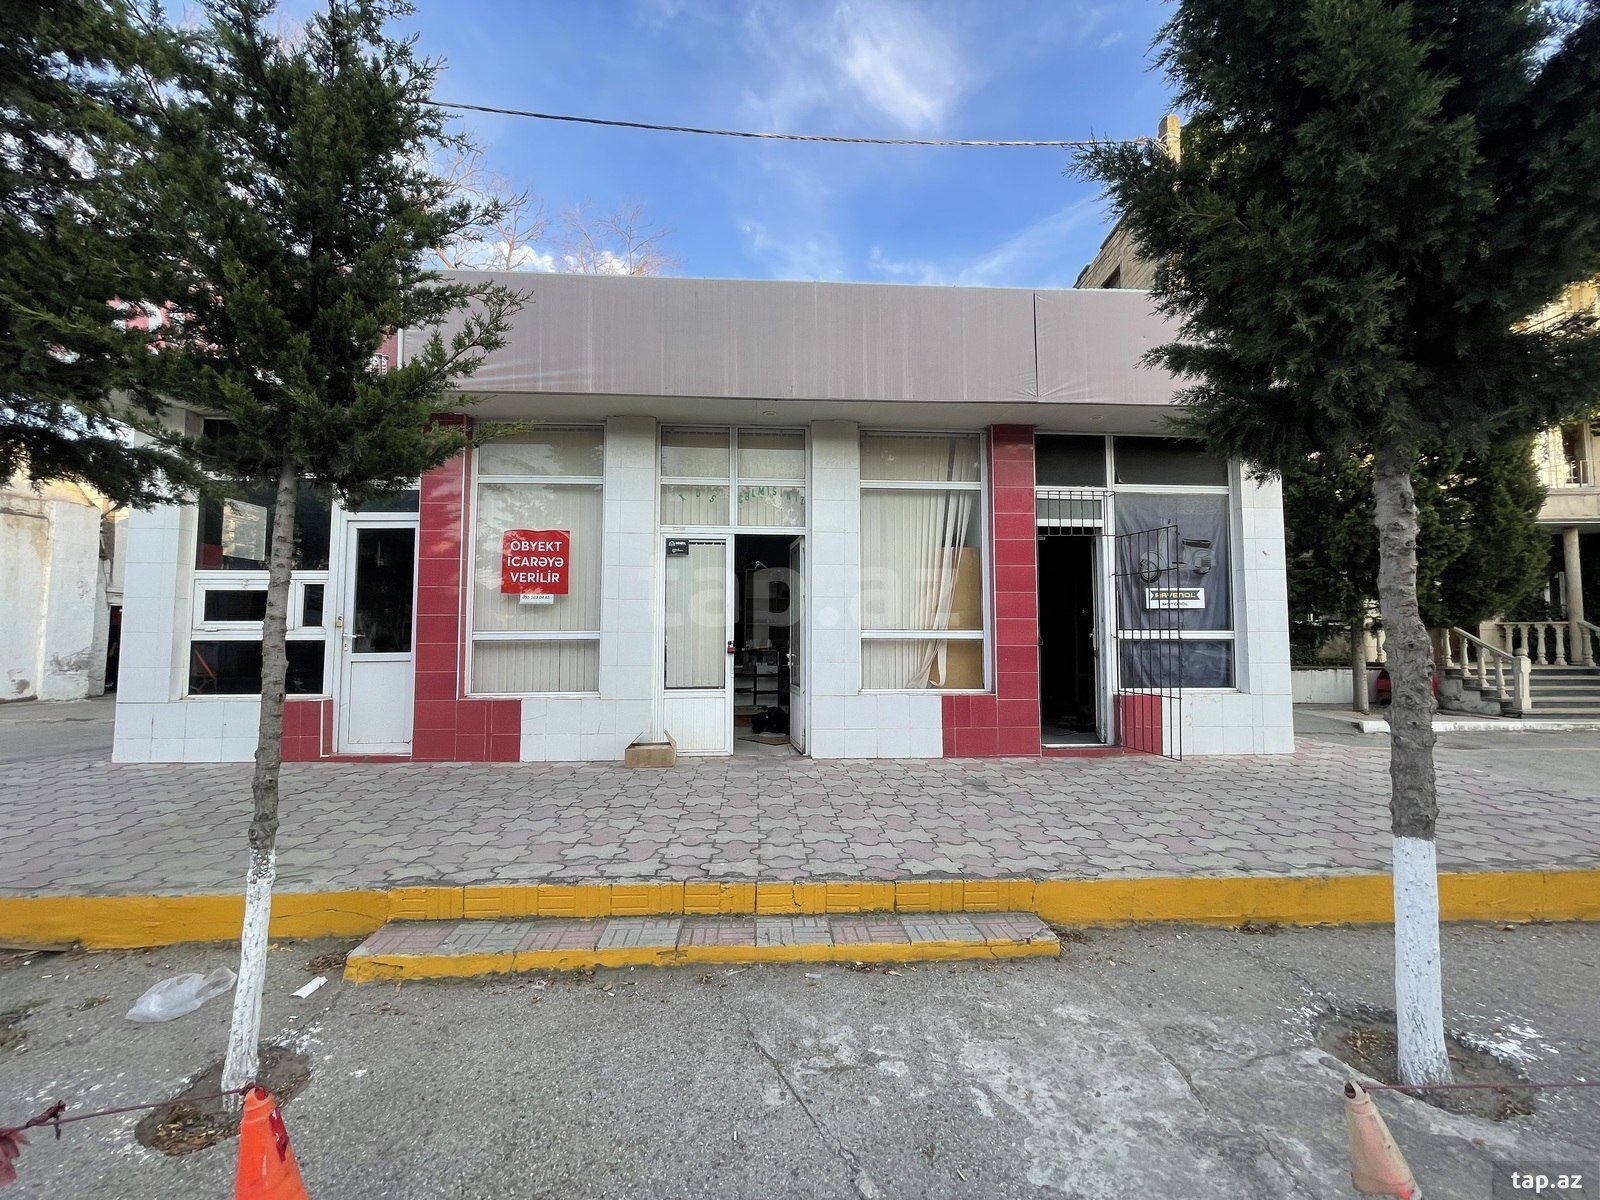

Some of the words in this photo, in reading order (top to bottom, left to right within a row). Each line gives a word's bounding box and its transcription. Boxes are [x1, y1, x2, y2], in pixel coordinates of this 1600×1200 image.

[510, 541, 562, 552] OBYEKT
[507, 554, 564, 567] İCARƏYƏ
[510, 570, 560, 583] VERİLİR
